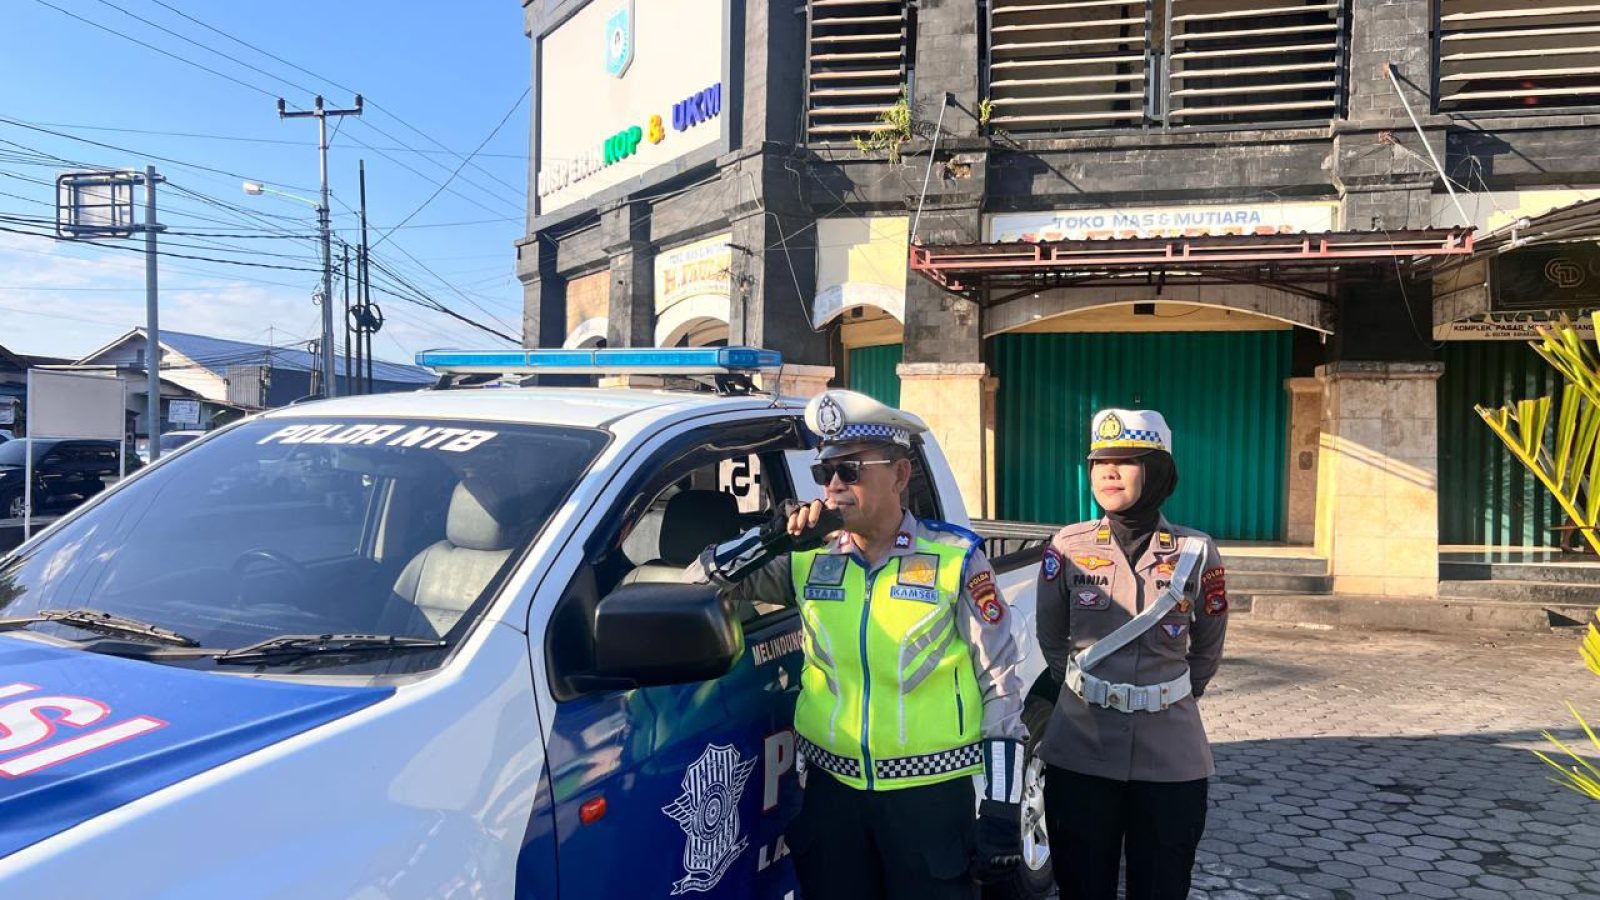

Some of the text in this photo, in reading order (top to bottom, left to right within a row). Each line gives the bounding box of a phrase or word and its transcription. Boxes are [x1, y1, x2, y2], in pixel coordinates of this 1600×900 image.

[647, 114, 665, 145] &
[672, 82, 720, 132] UKM
[1055, 216, 1104, 230] TOKO
[1113, 213, 1154, 228] MAS
[1174, 211, 1261, 226] MUTIARA
[1454, 324, 1491, 332] KOMPLEK
[256, 424, 498, 452] POLDA NTB
[969, 572, 989, 588] POLDA
[807, 589, 839, 599] SYAM
[0, 682, 171, 780] SI
